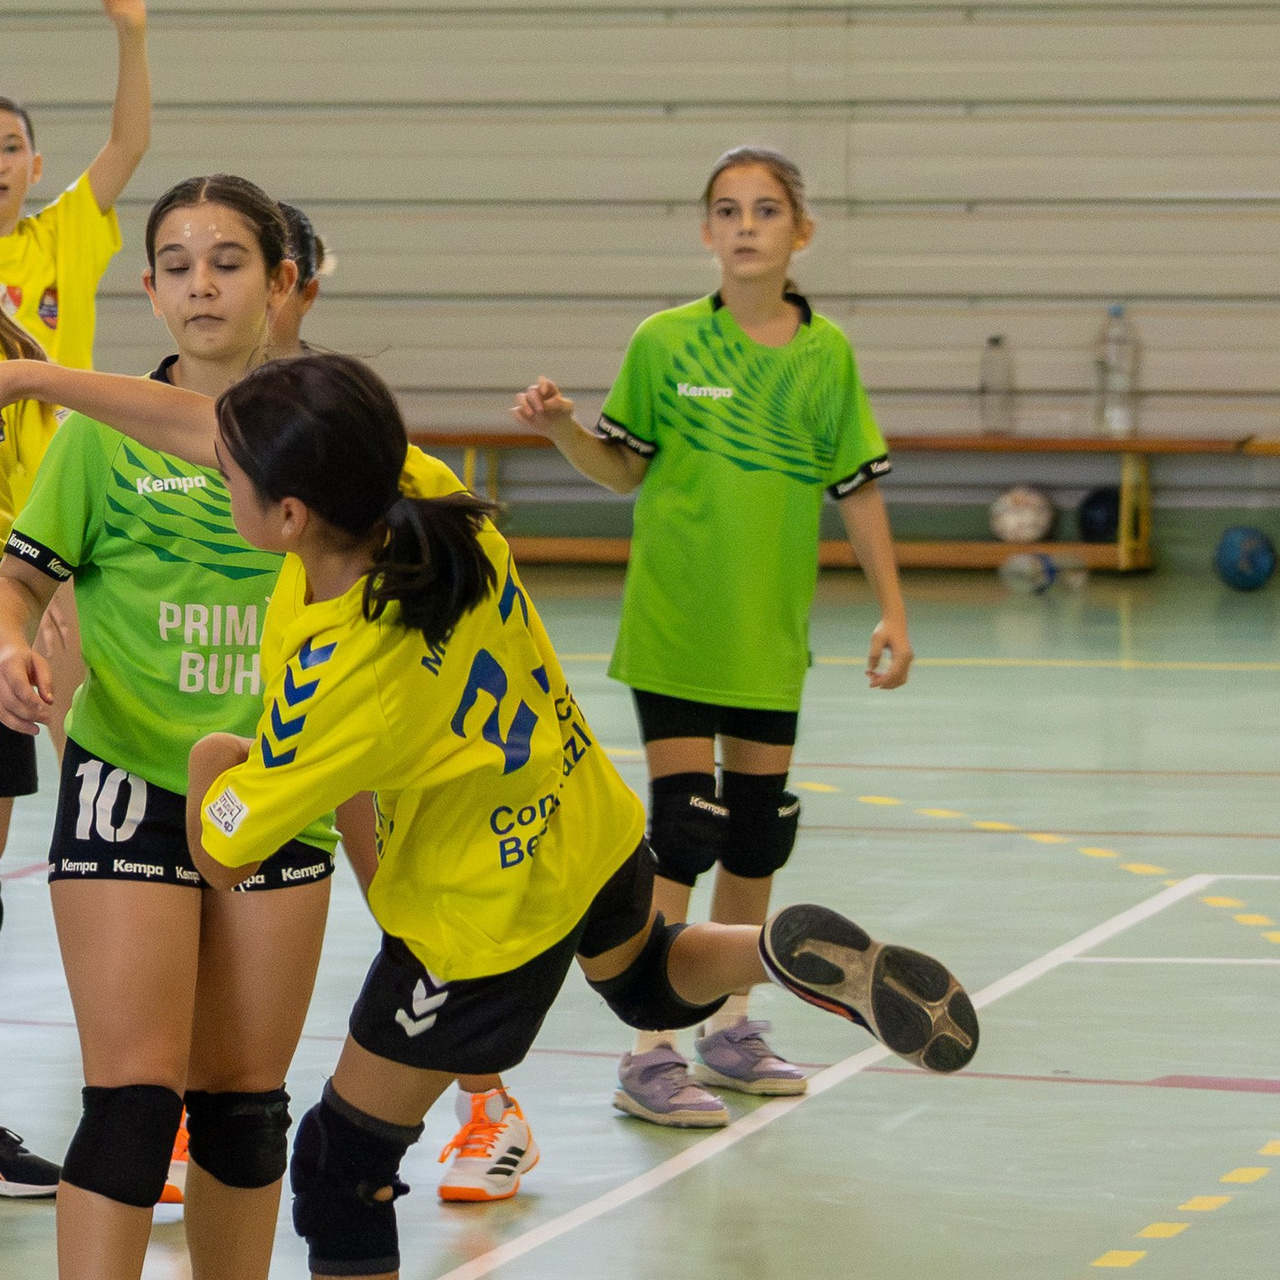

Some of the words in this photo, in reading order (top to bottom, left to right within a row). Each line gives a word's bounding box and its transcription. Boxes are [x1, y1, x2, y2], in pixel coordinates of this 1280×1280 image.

[677, 382, 733, 401] Kempa
[137, 475, 207, 495] Kempa
[179, 651, 260, 696] BUH
[75, 759, 148, 842] 10
[61, 858, 98, 875] Kempa
[113, 859, 165, 878] Kempa
[280, 861, 326, 882] Kempa
